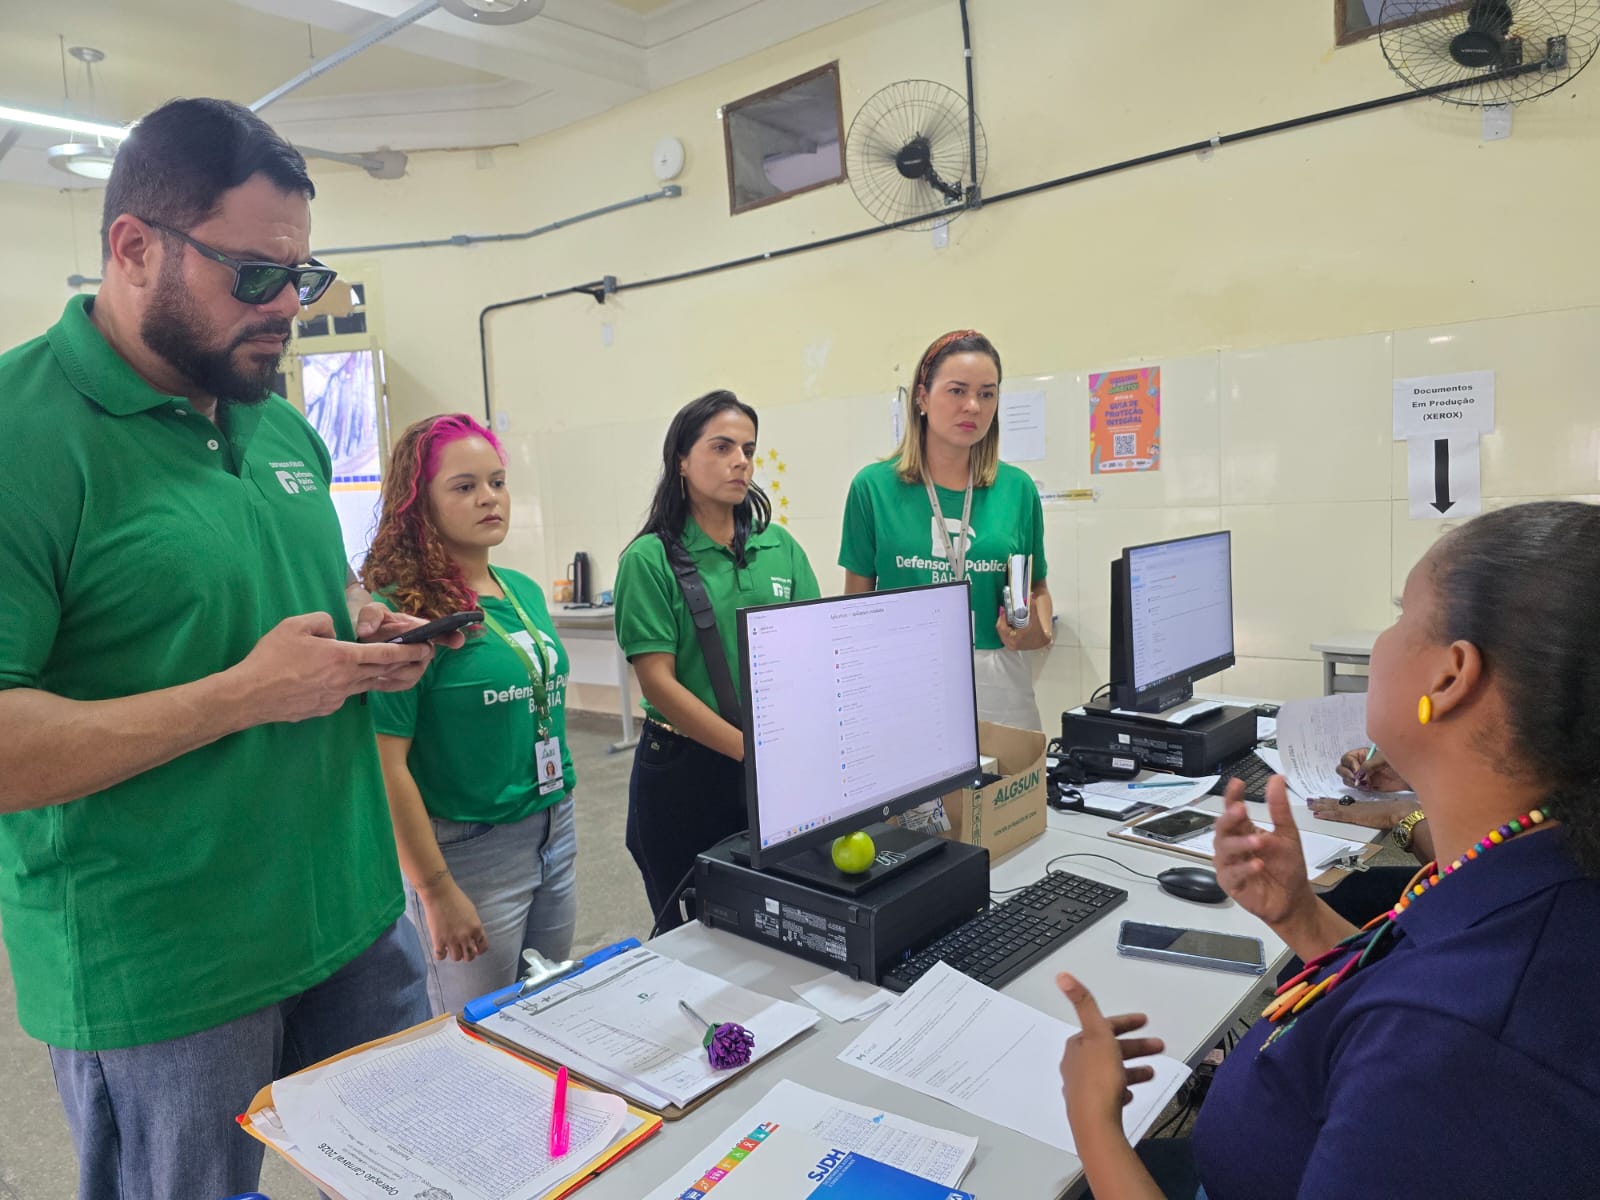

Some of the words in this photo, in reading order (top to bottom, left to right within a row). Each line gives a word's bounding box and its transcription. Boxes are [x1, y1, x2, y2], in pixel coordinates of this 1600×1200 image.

[1413, 385, 1473, 395] Documentos
[1429, 398, 1475, 408] Produção
[1423, 411, 1463, 421] (XEROX)
[931, 571, 973, 584] BAHA
[529, 691, 562, 713] BIA
[992, 769, 1040, 806] ALGSUN
[317, 1142, 338, 1158] 2026
[332, 1154, 366, 1176] Carnaval
[808, 1148, 846, 1182] SJDH
[364, 1173, 399, 1196] Operação
